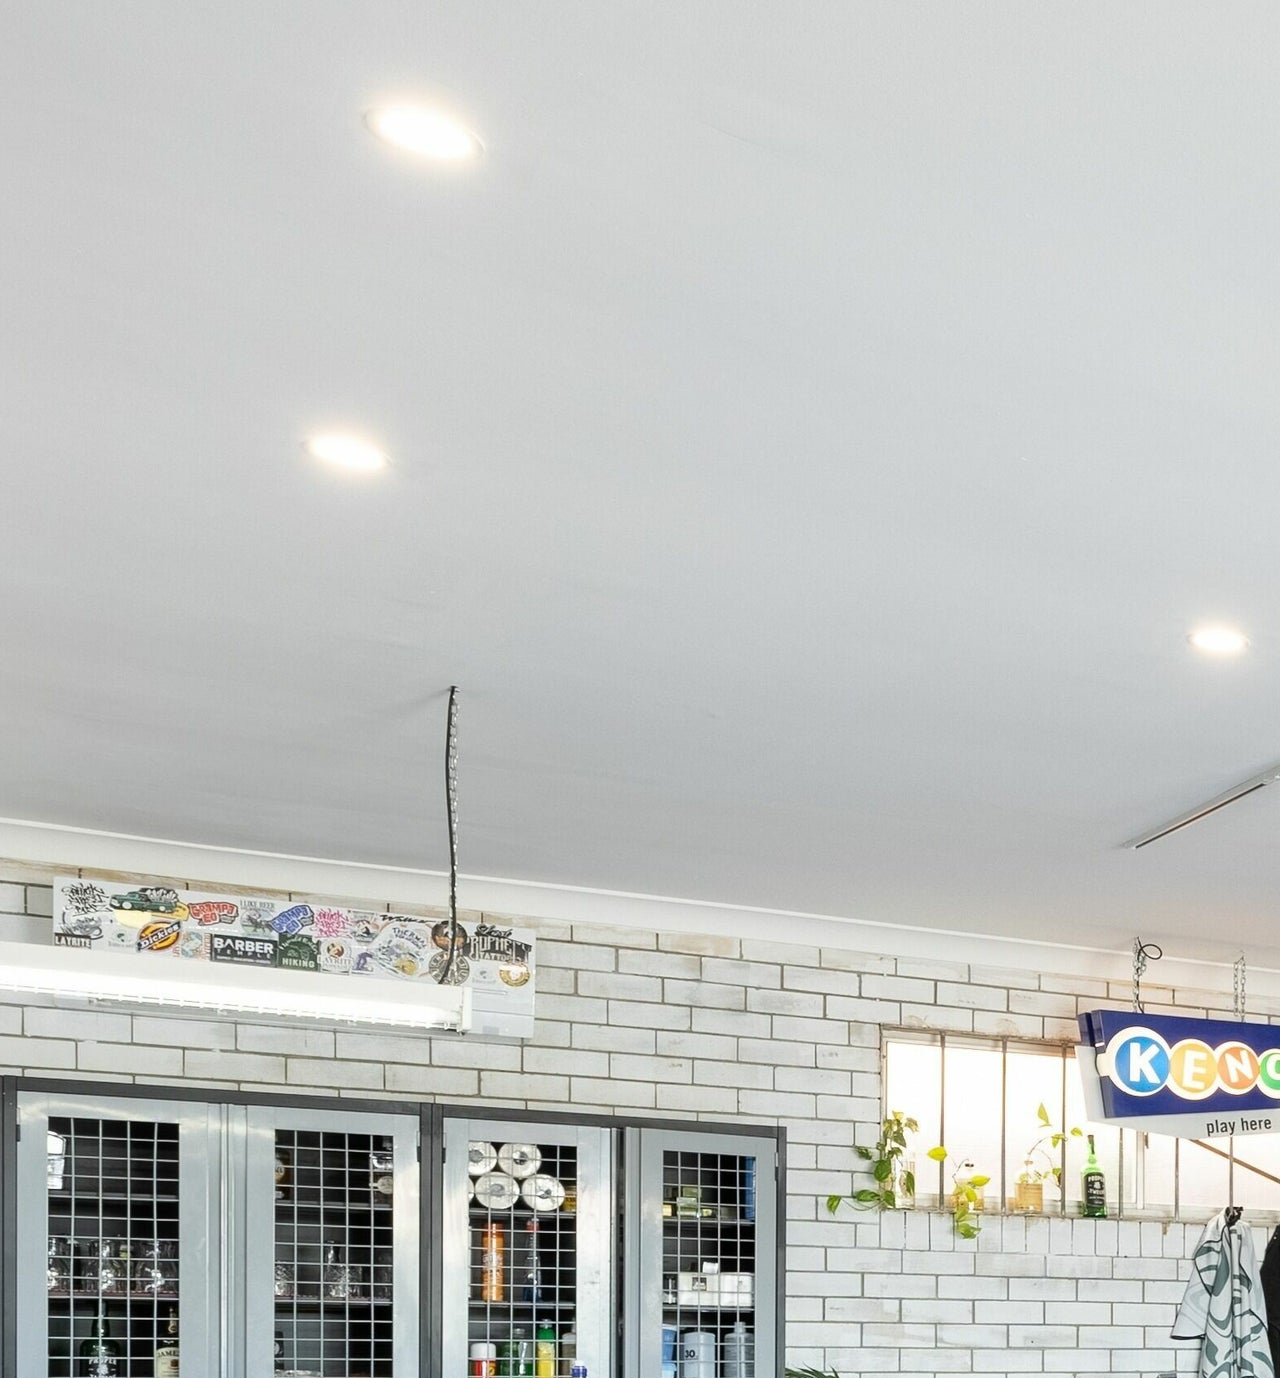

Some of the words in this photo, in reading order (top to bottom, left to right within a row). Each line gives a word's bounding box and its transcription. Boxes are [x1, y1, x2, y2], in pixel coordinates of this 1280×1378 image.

[55, 934, 92, 948] LAYRITE
[140, 923, 180, 949] Dickies
[214, 937, 274, 955] BARBER
[216, 949, 272, 960] TEMPLE
[281, 957, 316, 969] HIKING
[1206, 1119, 1235, 1137] play
[1241, 1117, 1272, 1132] here
[685, 1349, 696, 1358] 30
